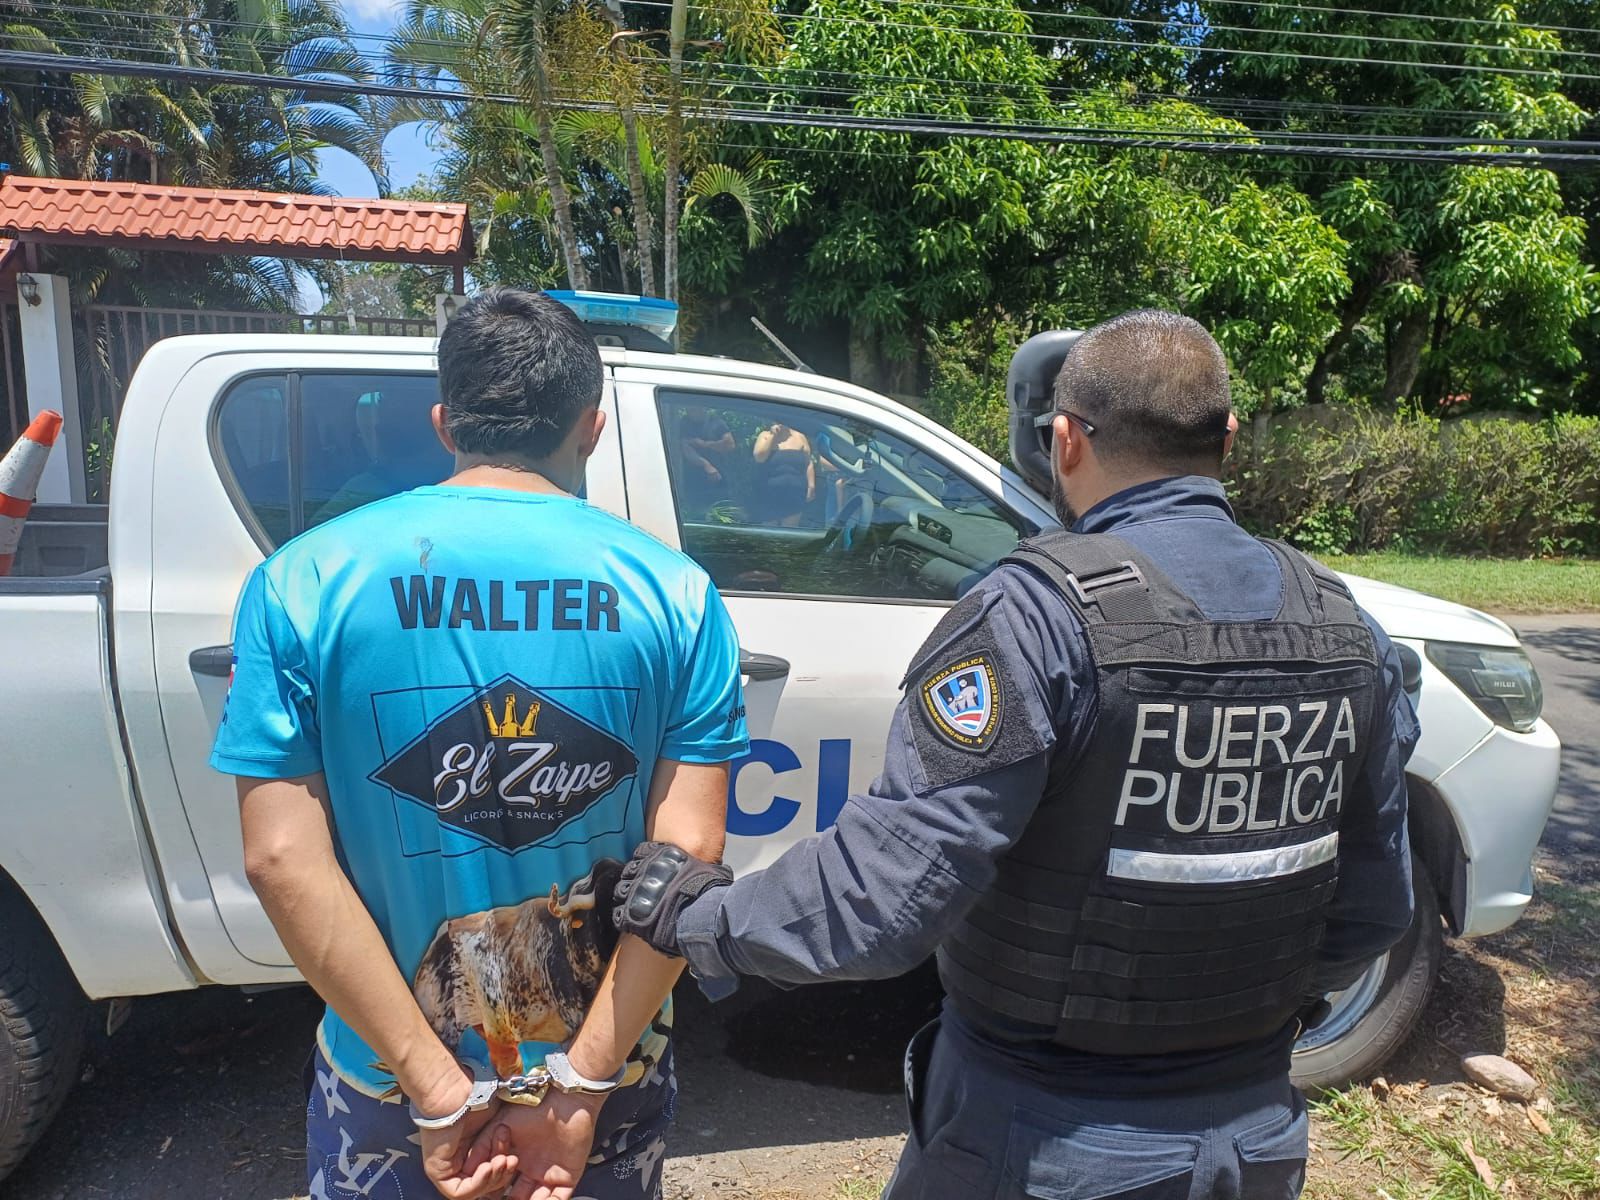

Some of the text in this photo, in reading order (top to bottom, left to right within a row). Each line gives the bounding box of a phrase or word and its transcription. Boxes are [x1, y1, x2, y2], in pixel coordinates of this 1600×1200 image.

[389, 574, 621, 633] WALTER
[951, 657, 985, 672] PUBLICA
[1128, 696, 1356, 768] FUERZA
[433, 741, 614, 812] El Zarpe
[1114, 760, 1344, 833] PUBLICA
[516, 810, 564, 820] SNACK'S
